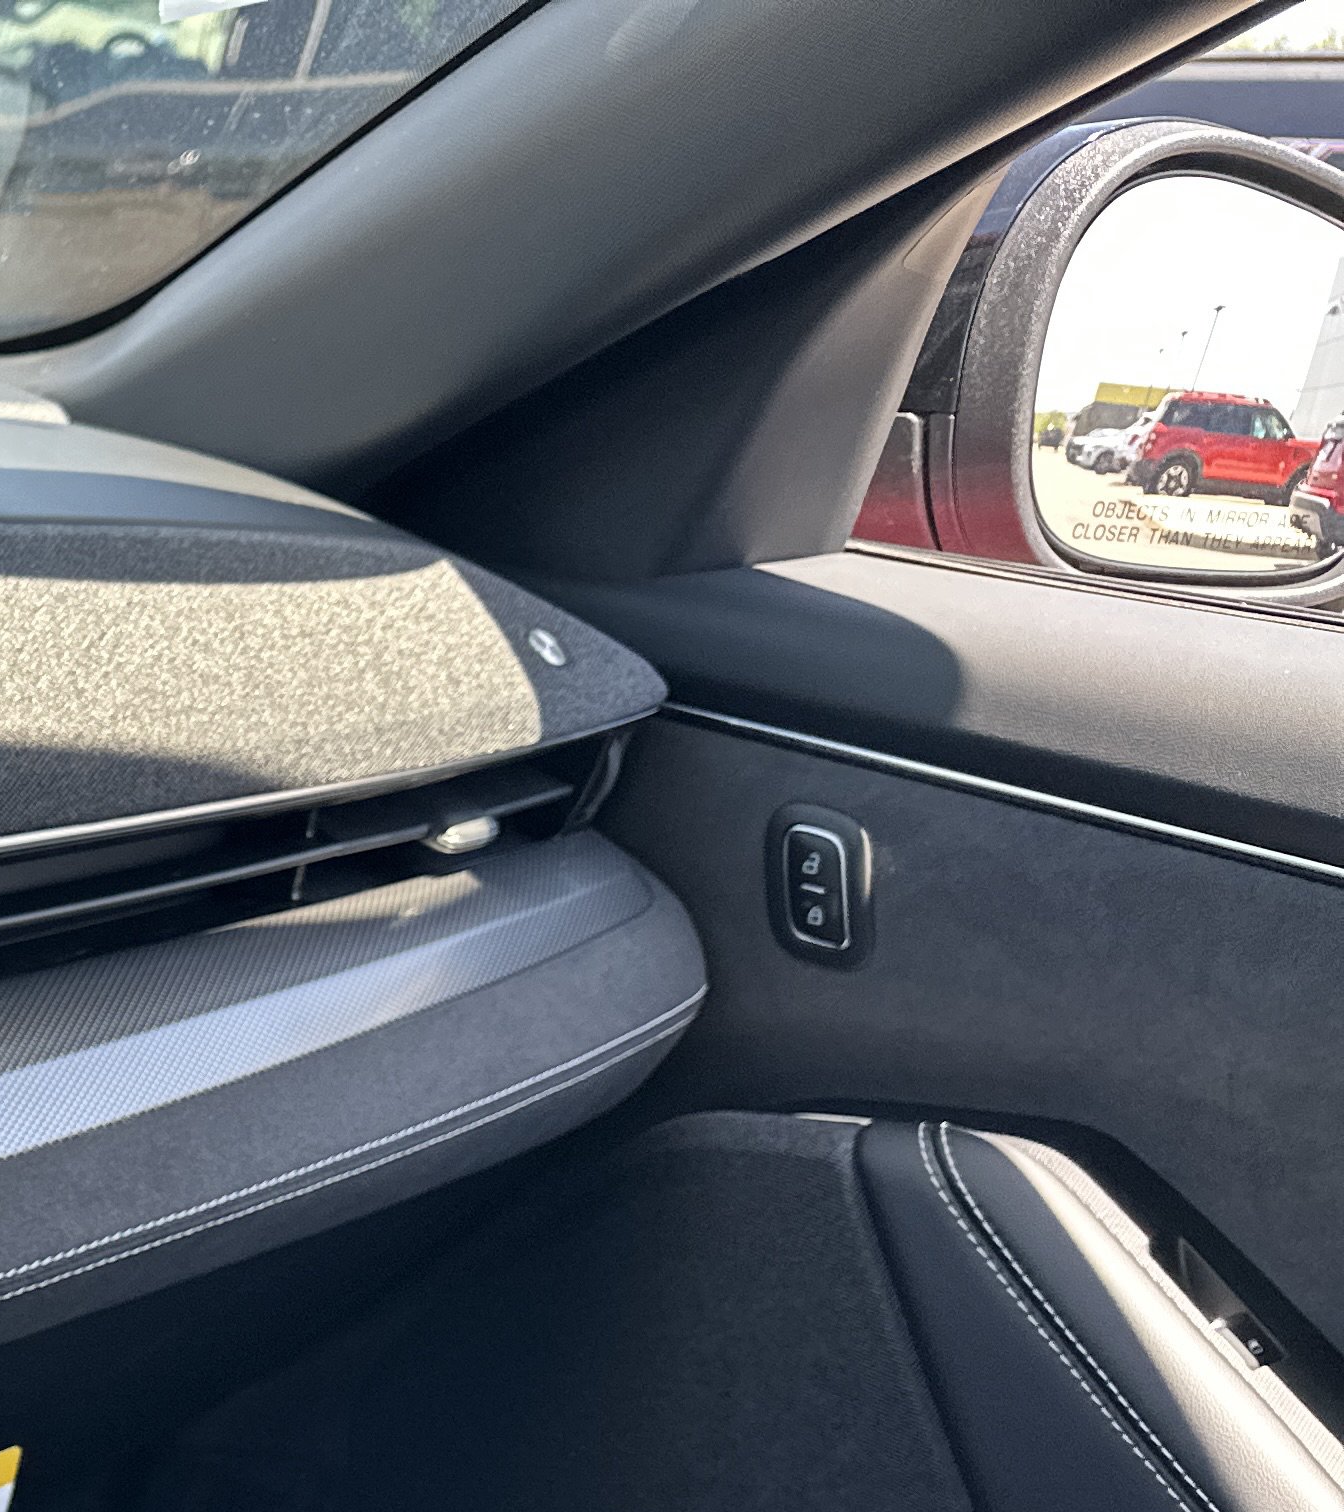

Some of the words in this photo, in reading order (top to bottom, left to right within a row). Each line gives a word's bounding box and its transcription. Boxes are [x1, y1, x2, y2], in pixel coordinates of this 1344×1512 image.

[1092, 500, 1169, 522] OBJECTS
[1181, 507, 1196, 523] IN
[1207, 508, 1271, 528] MIRROR
[1072, 522, 1141, 544] CLOSER
[1149, 528, 1194, 547] THAN
[1204, 532, 1242, 550] THEY
[1251, 536, 1314, 554] APPEAR
